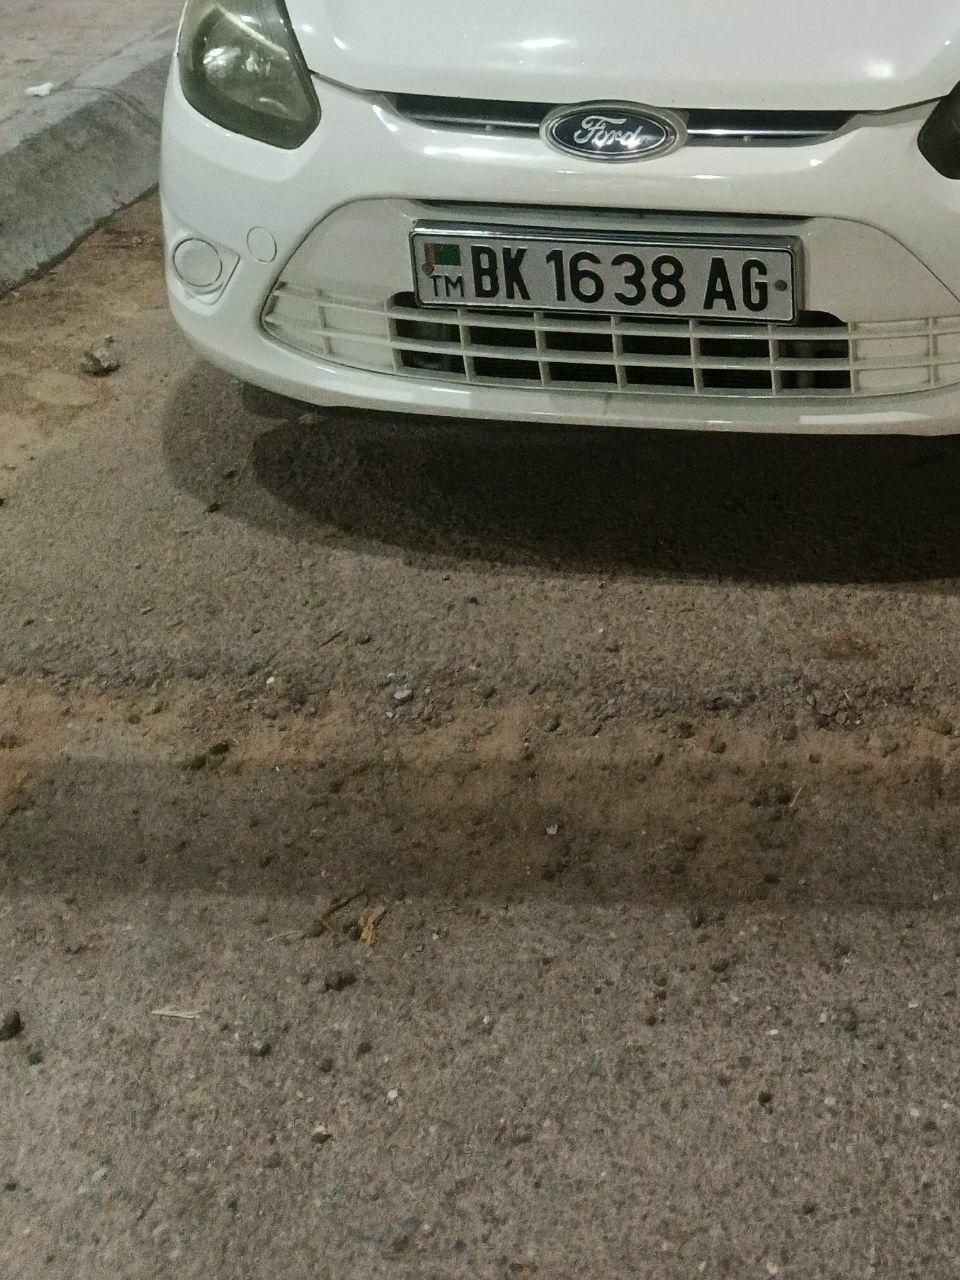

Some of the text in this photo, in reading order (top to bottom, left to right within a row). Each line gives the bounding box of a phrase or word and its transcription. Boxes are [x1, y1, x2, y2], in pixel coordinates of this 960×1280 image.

[573, 115, 651, 149] Ford
[429, 244, 768, 312] TM BK 1638 AG
